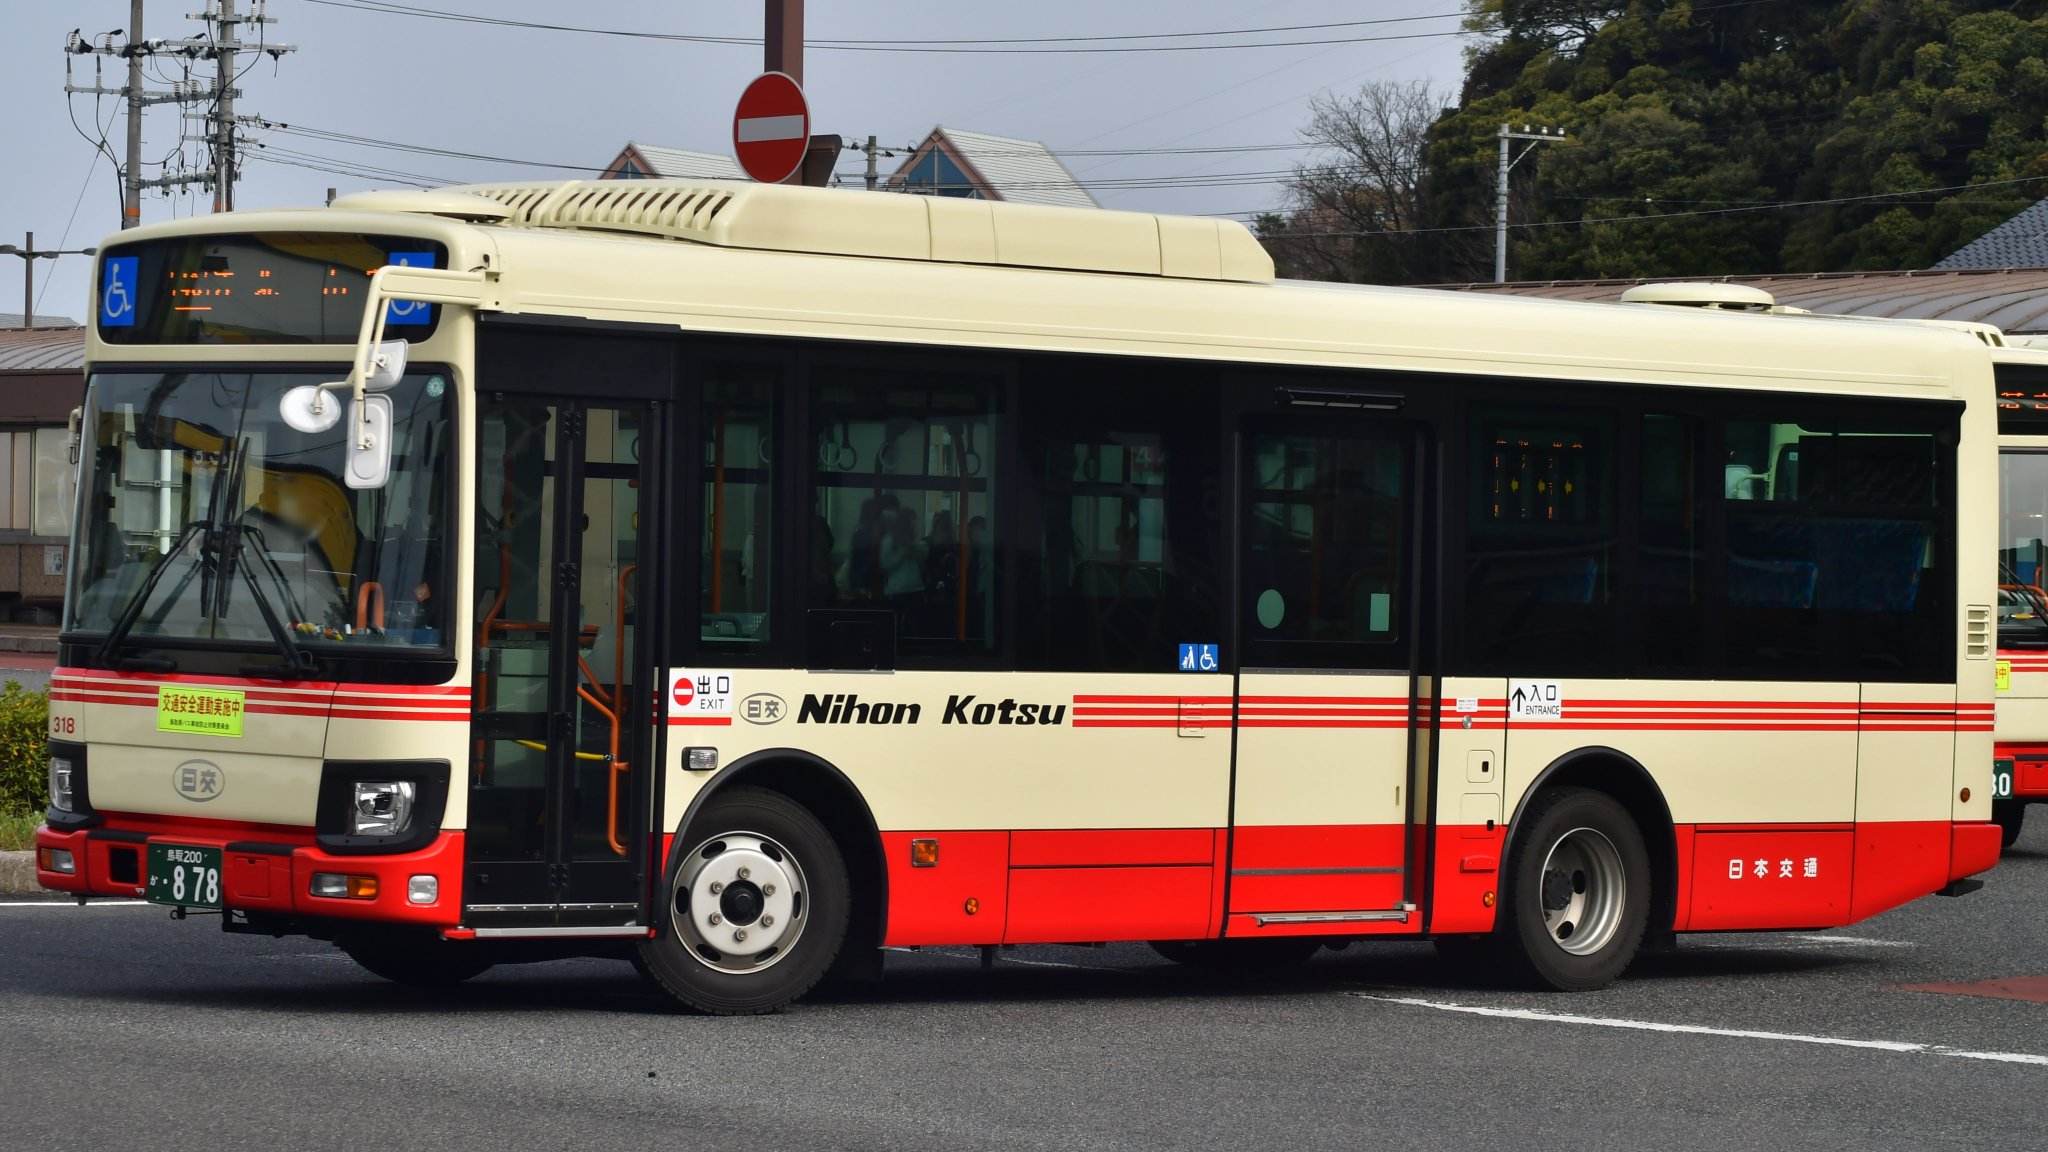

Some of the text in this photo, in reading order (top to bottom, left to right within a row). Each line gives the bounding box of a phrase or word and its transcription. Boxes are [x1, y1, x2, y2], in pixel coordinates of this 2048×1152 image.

[697, 675, 729, 694] 出口
[1530, 685, 1556, 701] 入口
[162, 693, 240, 717] 交通安全運動実施中
[700, 699, 724, 709] EXIT
[748, 700, 779, 718] 日交
[797, 694, 1066, 726] Nihon Kotsu
[1525, 705, 1559, 715] ENTRANCE
[54, 716, 75, 734] 318
[181, 768, 216, 794] 日交
[1728, 857, 1818, 879] 日本交通
